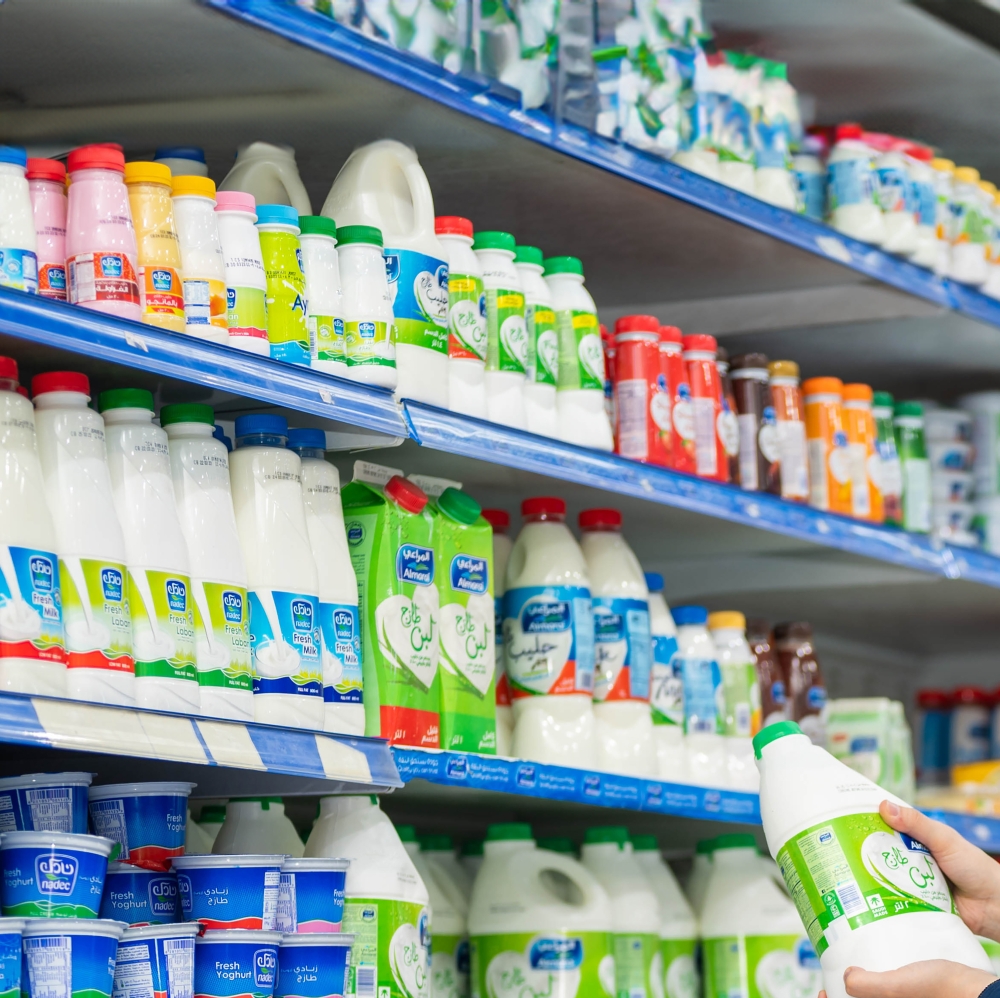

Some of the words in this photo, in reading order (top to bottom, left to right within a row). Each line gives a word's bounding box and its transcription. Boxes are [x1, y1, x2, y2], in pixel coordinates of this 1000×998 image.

[402, 549, 430, 562] المراعي
[31, 560, 51, 574] نادك
[456, 558, 484, 572] المراعي
[102, 571, 121, 585] نادك
[34, 579, 50, 588] nadec
[105, 590, 120, 598] nadec
[168, 582, 185, 596] نادك
[33, 593, 52, 605] Fresh
[170, 600, 184, 608] nadec
[224, 594, 242, 607] نادك
[44, 605, 57, 617] Milk
[104, 604, 122, 614] Fresh
[294, 604, 312, 616] نادك
[170, 614, 186, 625] Fresh
[226, 612, 240, 620] nadec
[336, 613, 352, 626] نادك
[400, 601, 422, 628] طازج
[296, 620, 310, 628] nadec
[225, 624, 242, 636] Fresh
[338, 630, 351, 638] nadec
[410, 614, 437, 652] لبن
[294, 633, 311, 644] Fresh
[465, 622, 492, 660] لبن
[304, 645, 316, 656] Milk
[336, 643, 352, 653] Fresh
[345, 654, 357, 663] Milk
[167, 814, 182, 822] Fresh
[882, 846, 908, 870] طازج
[40, 859, 74, 875] نادك
[909, 855, 935, 889] لبن
[42, 880, 70, 890] nadec
[153, 882, 176, 896] نادك
[110, 892, 134, 900] Fresh
[204, 888, 228, 898] زبادي
[112, 900, 147, 910] Yoghurt
[154, 902, 174, 911] nadec
[208, 897, 228, 906] طازج
[894, 902, 904, 912] لتر
[216, 962, 240, 970] Fresh
[257, 954, 275, 968] نادك
[294, 965, 318, 974] زبادي
[216, 970, 252, 980] Yoghurt
[258, 973, 273, 983] nadec
[297, 975, 317, 983] طازج
